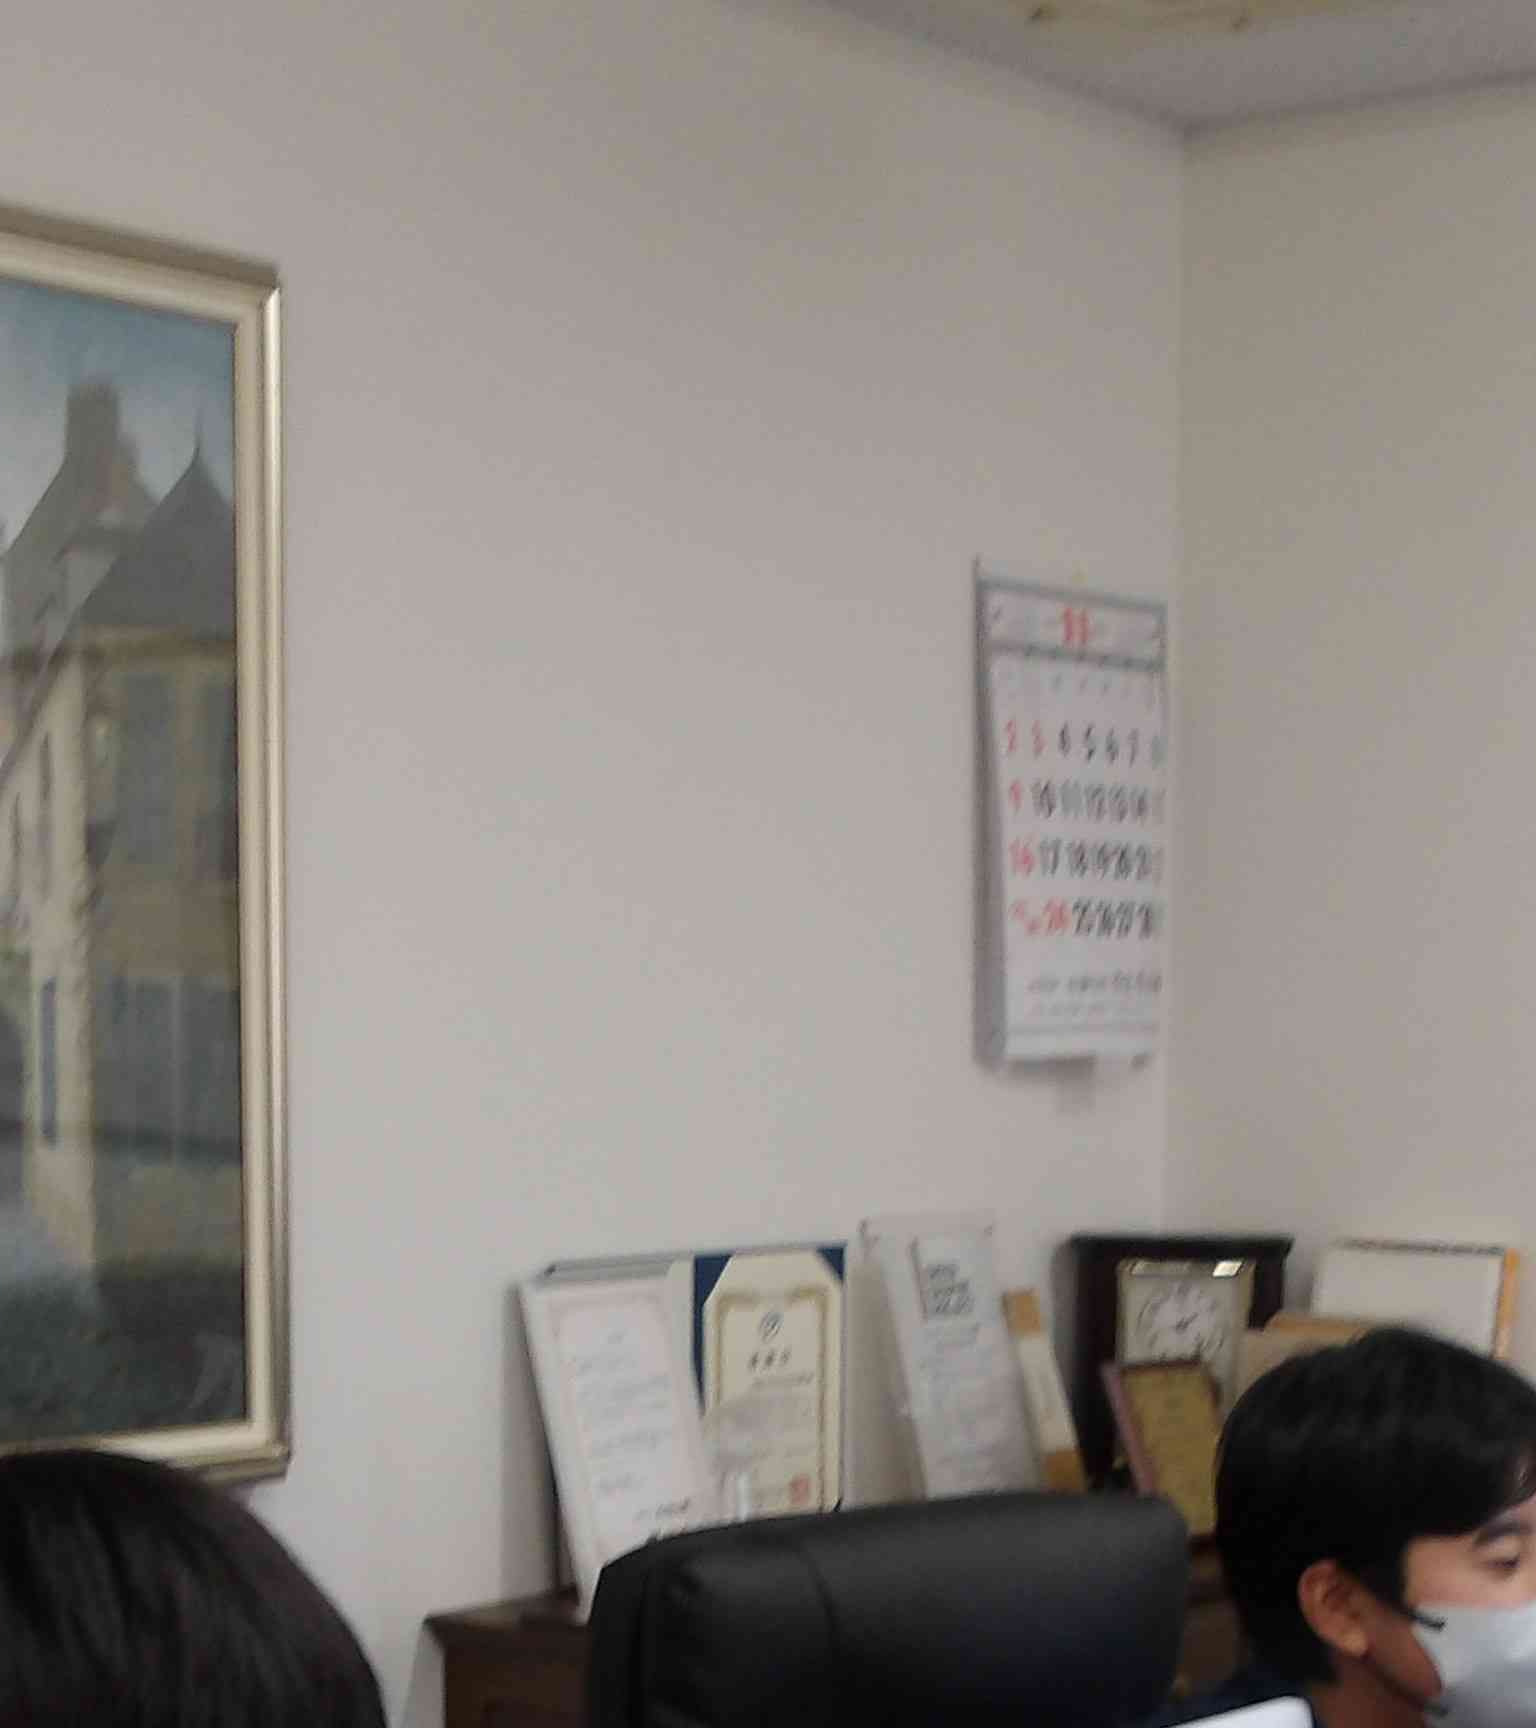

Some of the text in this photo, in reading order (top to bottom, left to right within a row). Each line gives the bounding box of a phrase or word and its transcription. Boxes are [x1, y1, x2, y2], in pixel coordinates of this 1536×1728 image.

[1063, 606, 1089, 646] 11
[1083, 723, 1096, 763] 5
[1009, 835, 1035, 876] 16
[1039, 836, 1062, 877] 17
[1067, 838, 1089, 878] 18
[1072, 898, 1095, 936] 25
